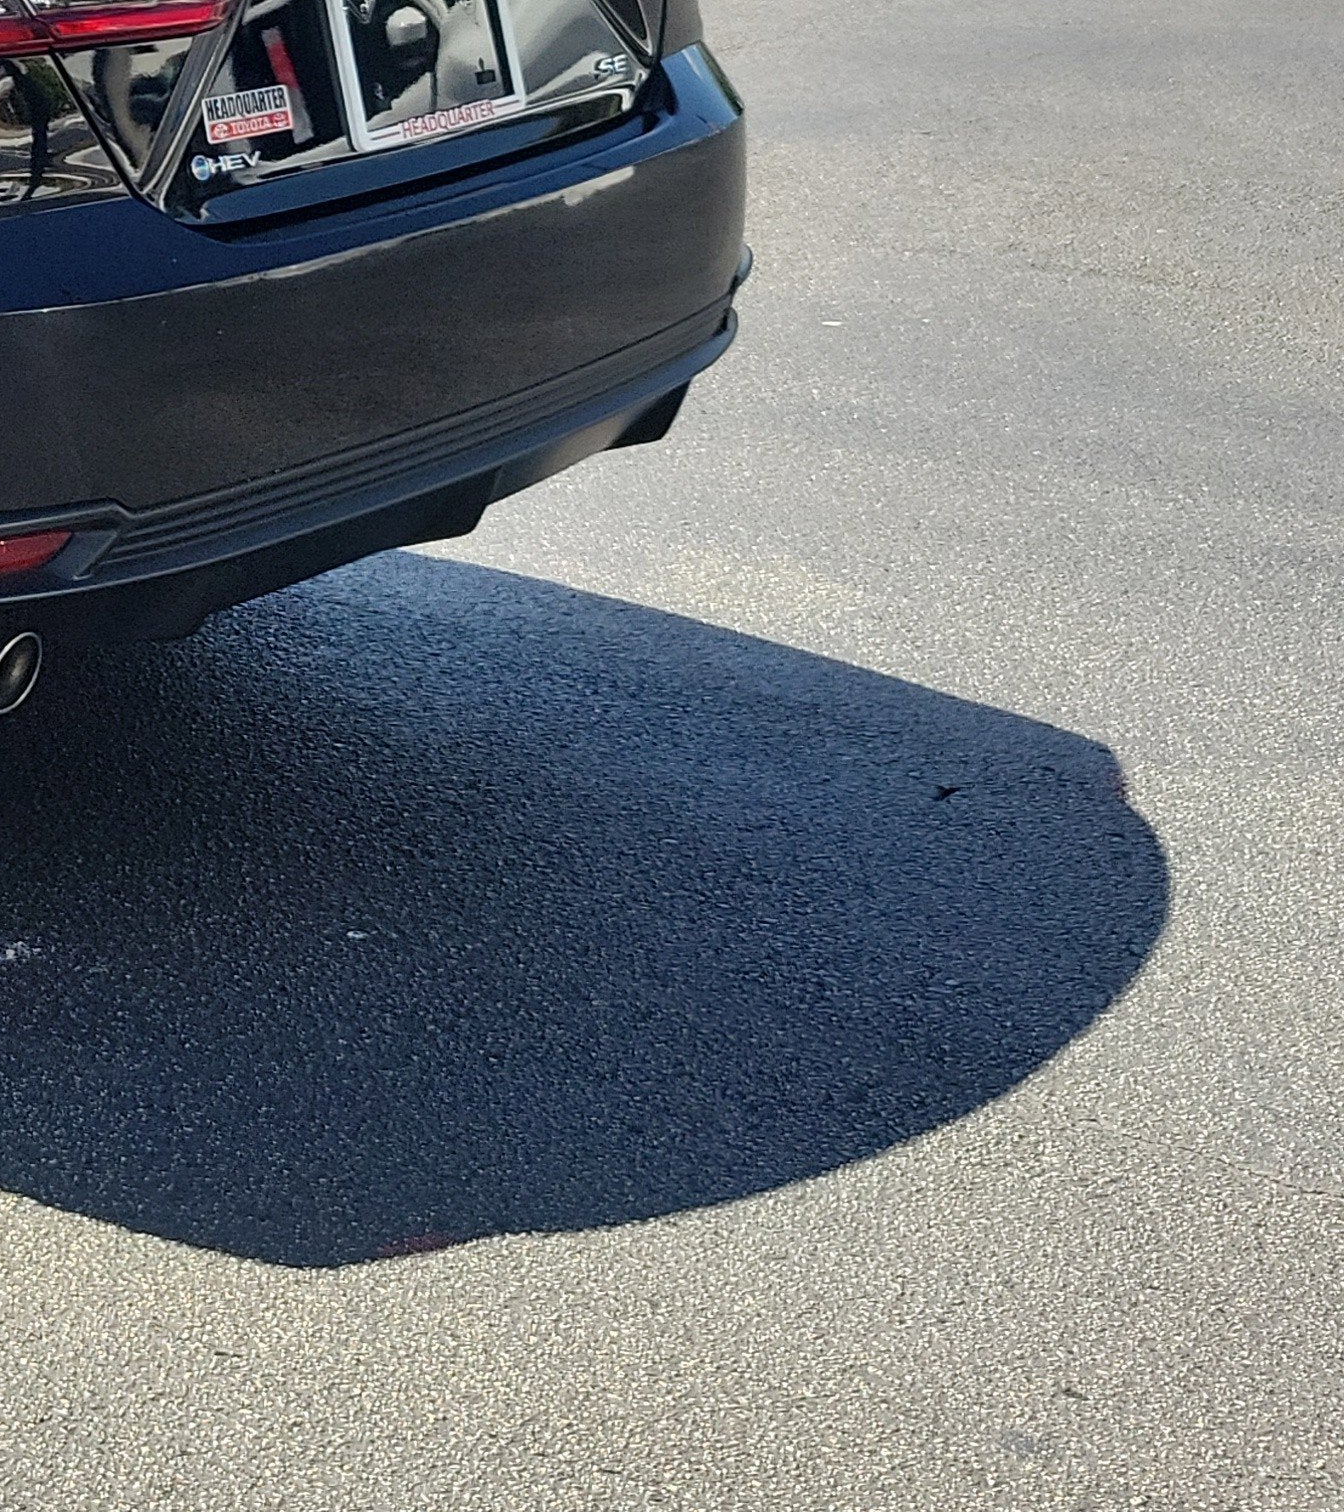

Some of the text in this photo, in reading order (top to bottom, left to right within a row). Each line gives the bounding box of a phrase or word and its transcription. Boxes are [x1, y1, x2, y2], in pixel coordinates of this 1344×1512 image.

[596, 54, 629, 76] SE
[204, 87, 287, 121] HEADQUARTER
[231, 116, 273, 135] TOYOTA
[401, 100, 495, 138] HEADQUARTER
[206, 150, 262, 174] HEV
